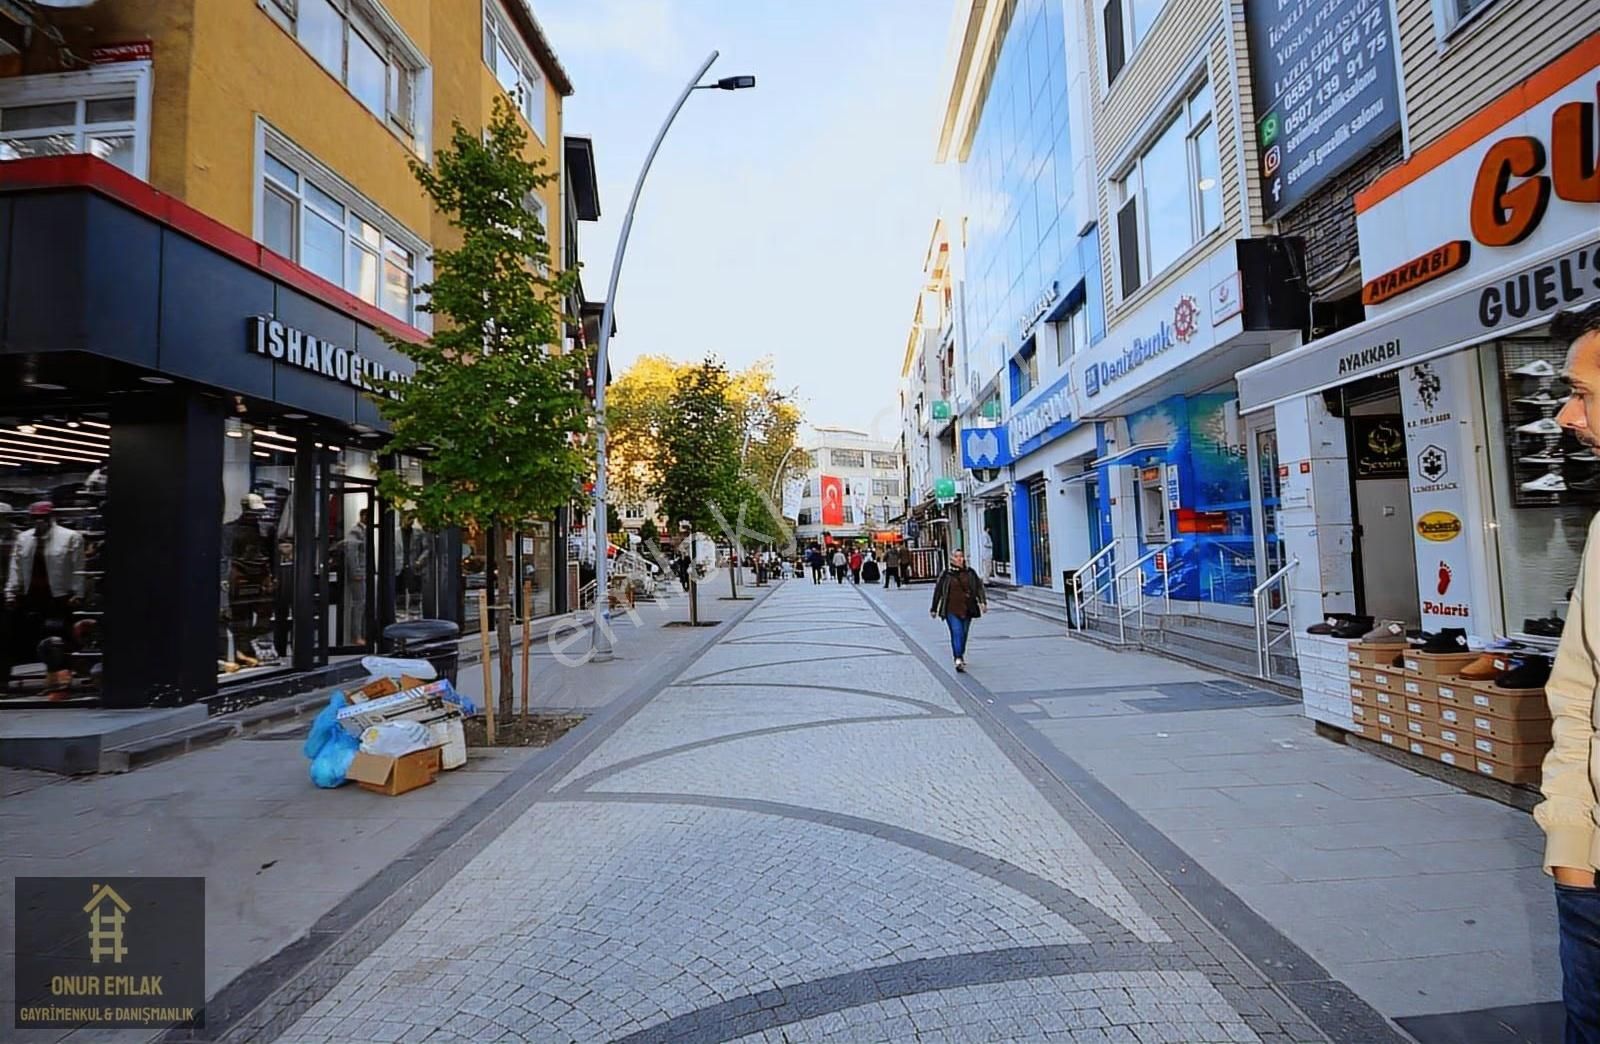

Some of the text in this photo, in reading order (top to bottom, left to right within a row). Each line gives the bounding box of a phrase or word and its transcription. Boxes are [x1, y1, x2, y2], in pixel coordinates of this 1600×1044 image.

[1284, 7, 1384, 111] 0553 704 64 72
[1284, 30, 1387, 134] 0507 139 91 75
[1369, 247, 1450, 300] AYAKKABI
[1339, 339, 1400, 374] AYAKKABI
[1423, 601, 1469, 617] Polaris
